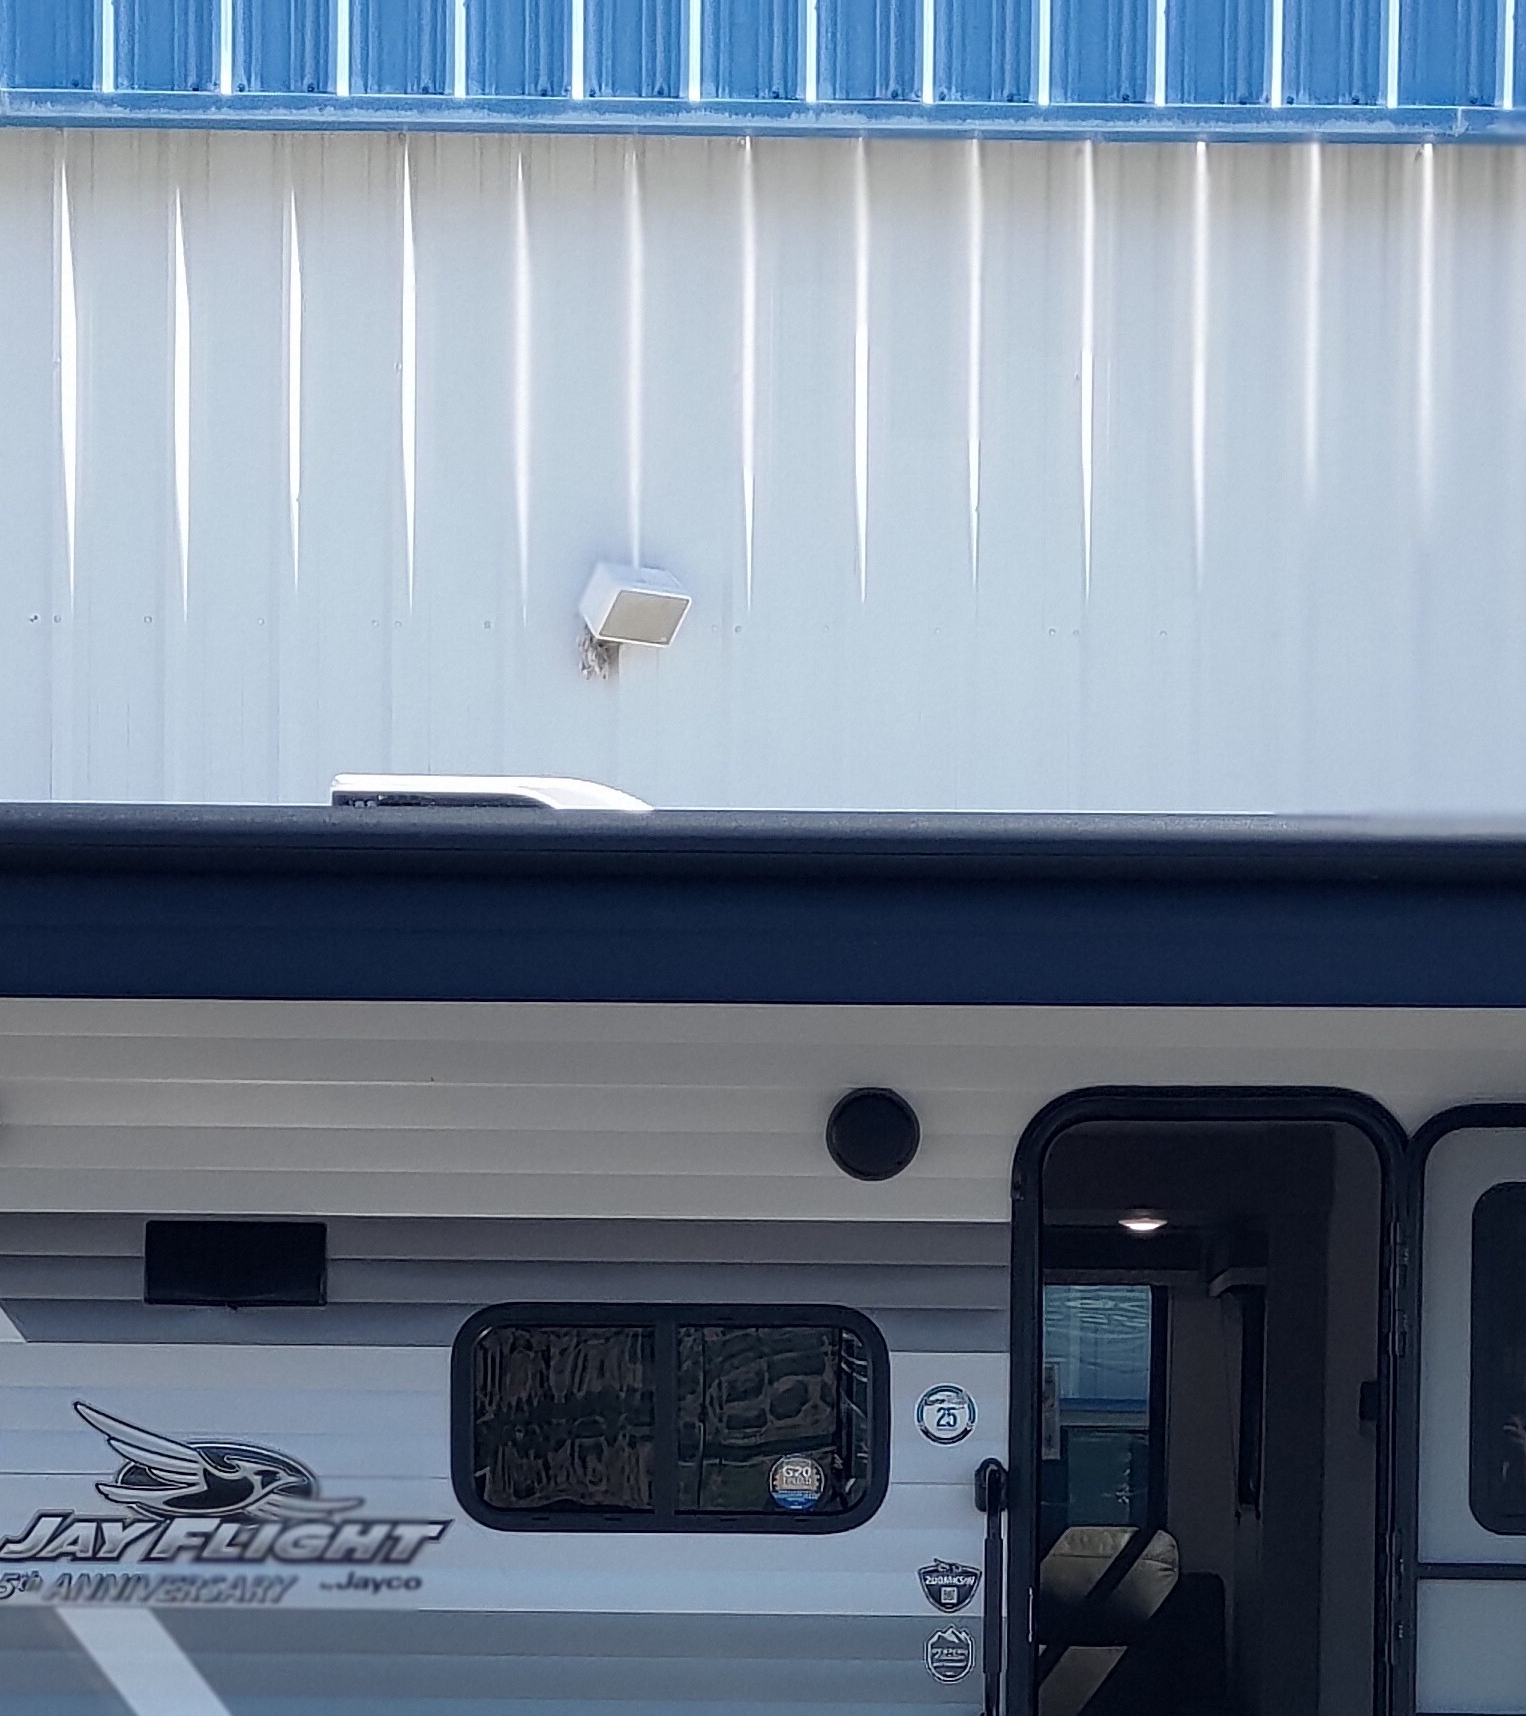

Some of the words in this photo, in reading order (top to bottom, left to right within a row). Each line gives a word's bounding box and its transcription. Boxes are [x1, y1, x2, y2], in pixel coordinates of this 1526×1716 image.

[936, 1406, 958, 1428] 25
[139, 1517, 454, 1564] FLIGHT
[42, 1573, 299, 1604] ANNIVERSARY
[336, 1570, 423, 1597] Jayco
